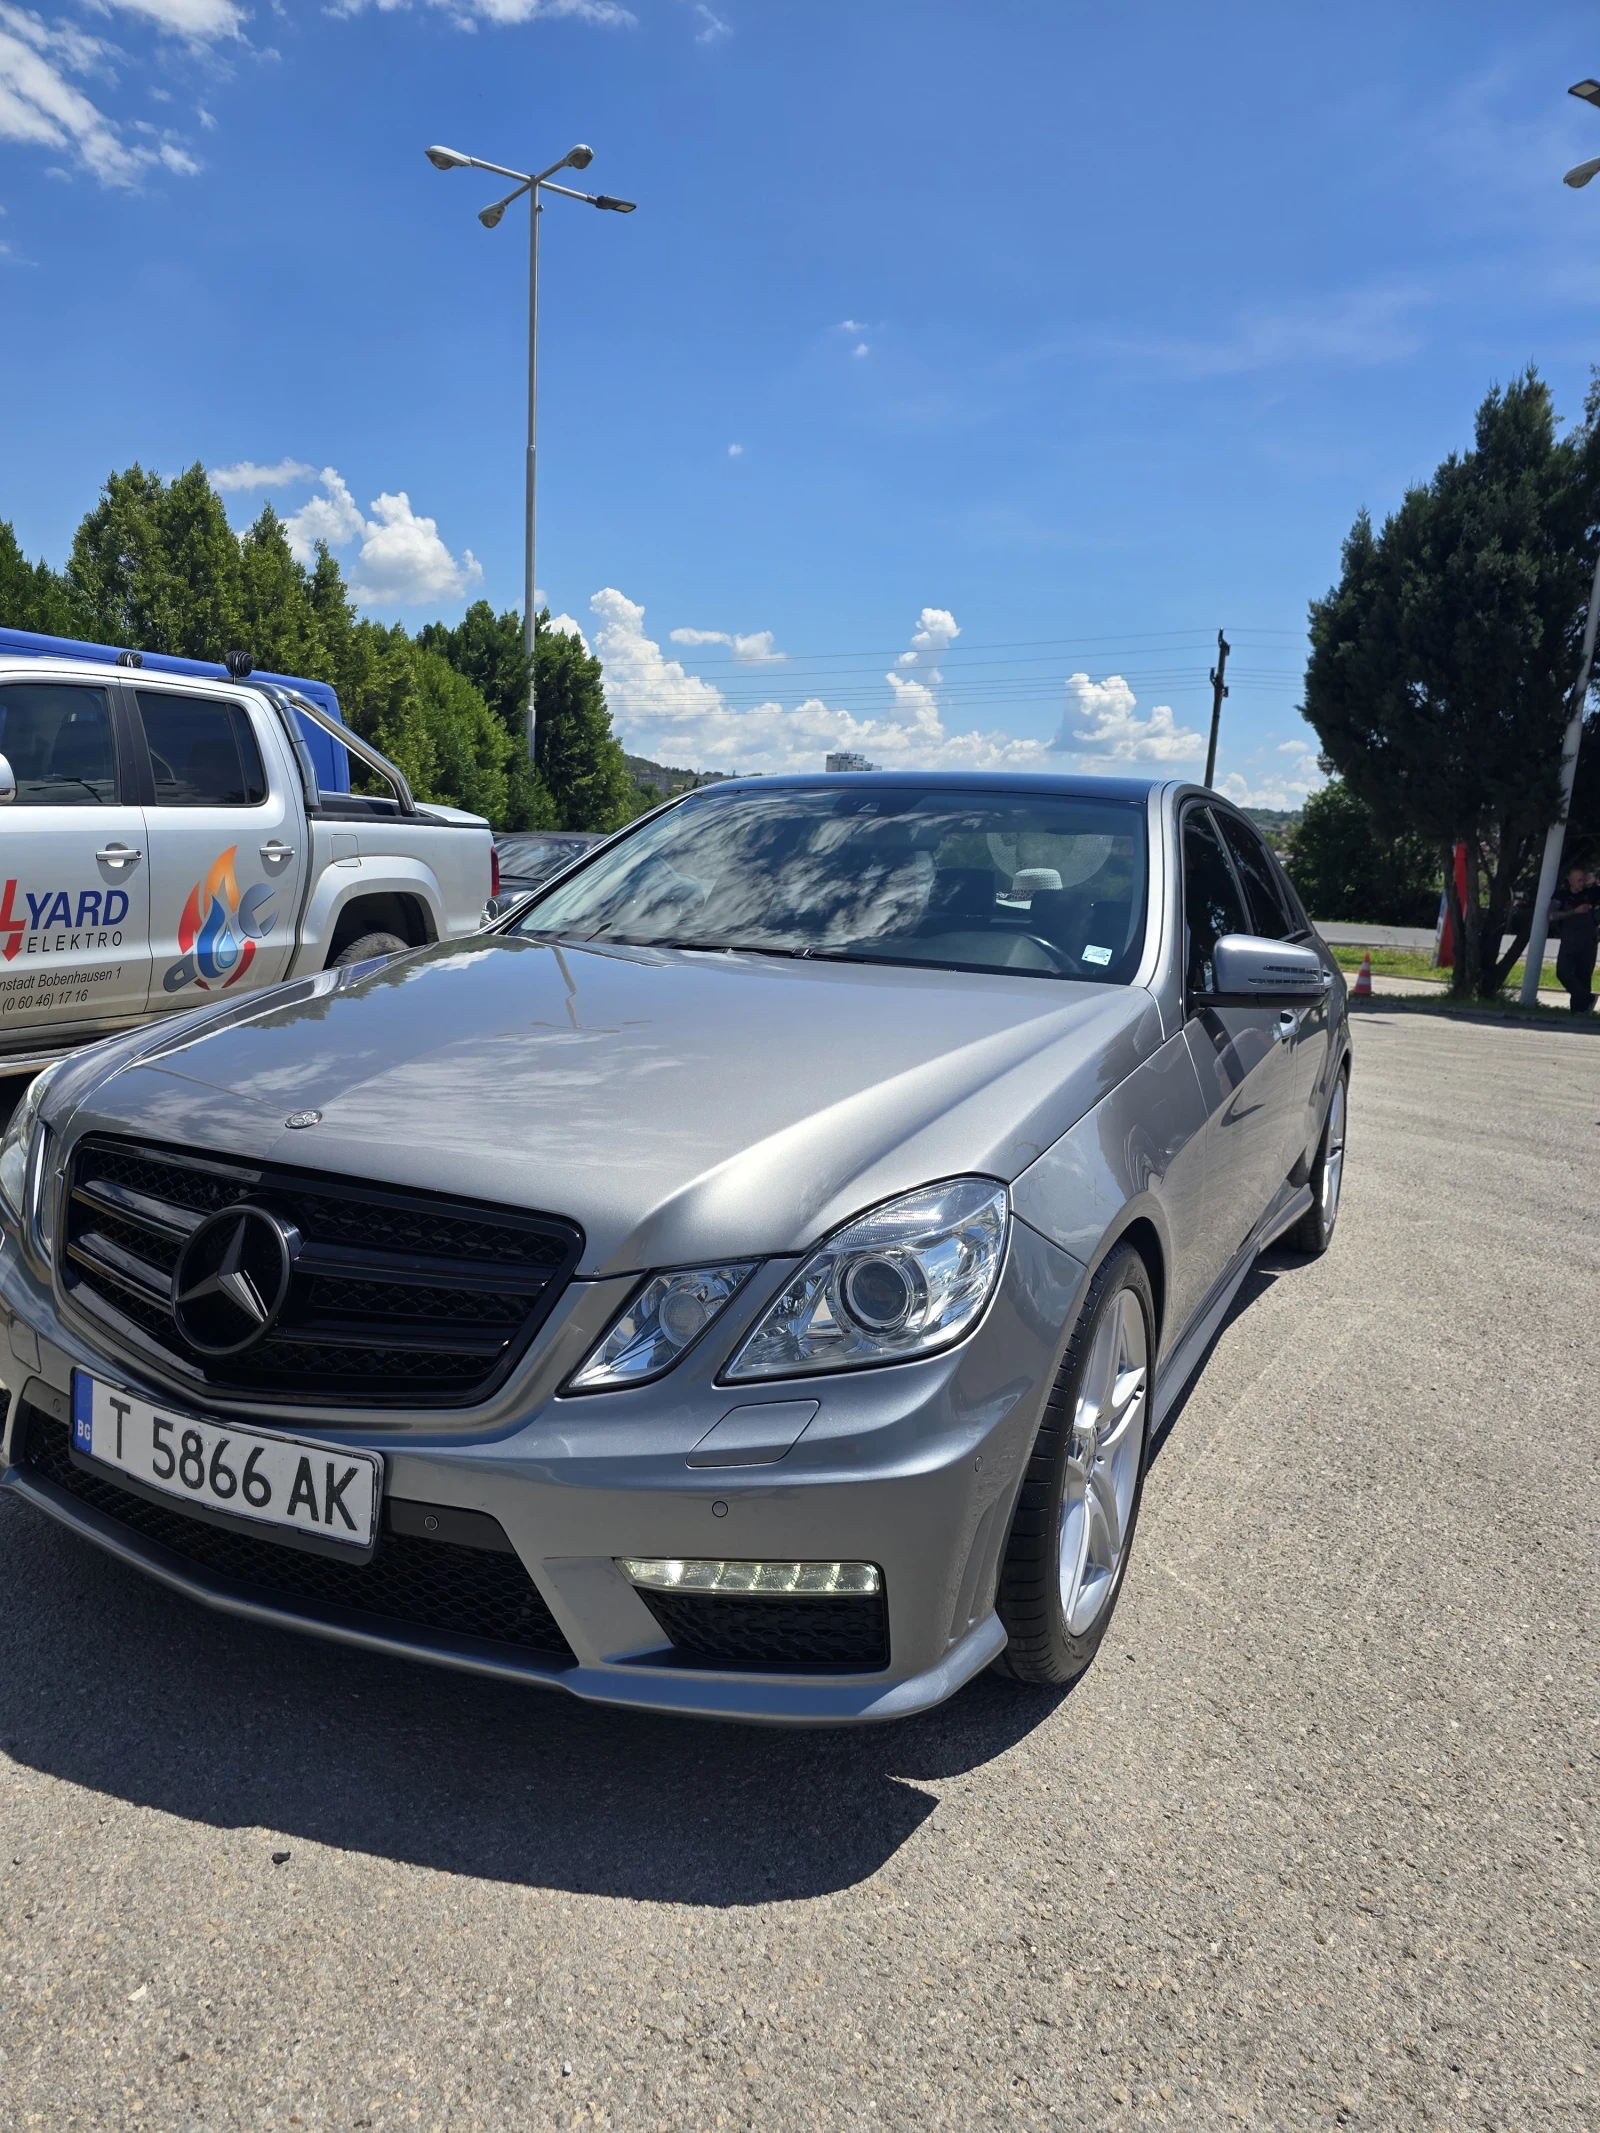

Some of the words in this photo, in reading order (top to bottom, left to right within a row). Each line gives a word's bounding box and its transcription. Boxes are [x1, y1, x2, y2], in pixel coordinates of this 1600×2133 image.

[27, 931, 123, 954] ELEKTRO
[38, 970, 112, 988] Bobenhausen
[116, 966, 122, 980] 1
[2, 997, 15, 1014] (0
[17, 995, 33, 1010] 60
[35, 993, 54, 1009] 46)
[58, 991, 73, 1004] 17
[75, 989, 89, 1002] 16
[77, 1419, 91, 1441] BG
[110, 1397, 131, 1460] T
[152, 1416, 272, 1508] 5866
[286, 1456, 359, 1531] AK
